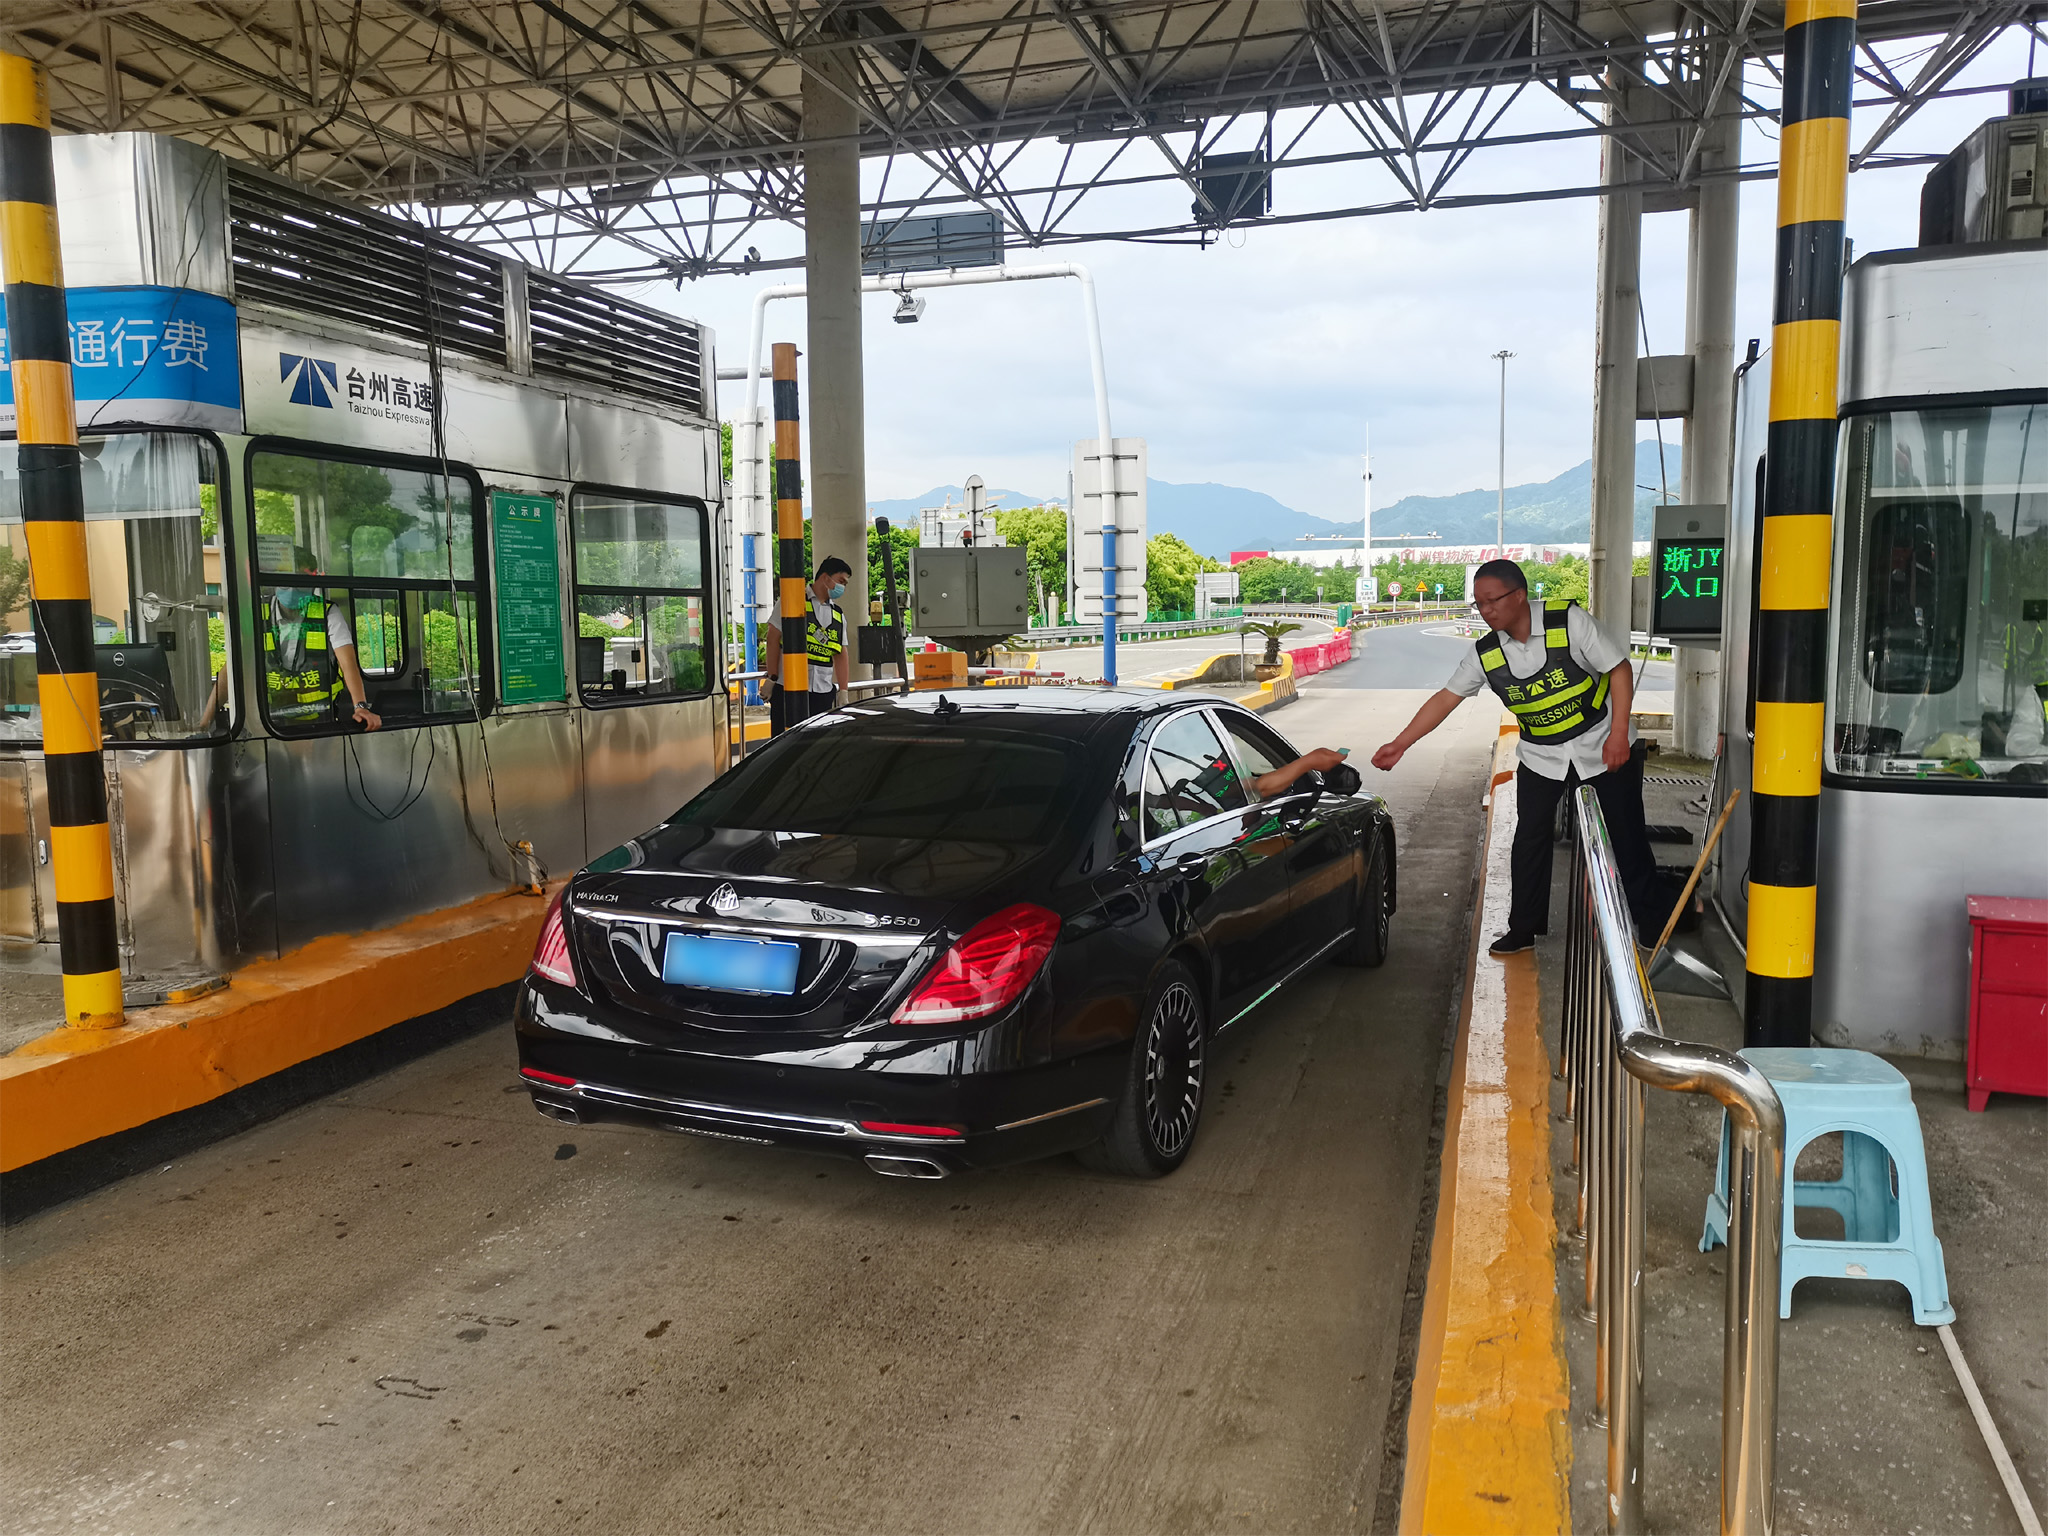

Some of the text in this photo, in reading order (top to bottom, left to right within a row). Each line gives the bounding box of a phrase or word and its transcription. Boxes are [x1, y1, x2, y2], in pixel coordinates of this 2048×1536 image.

[67, 317, 209, 371] 通行费
[346, 367, 434, 412] 台州高速
[348, 401, 434, 425] Taizhou Expresswa
[1663, 547, 1723, 572] 浙JY
[1662, 575, 1719, 599] 入口
[576, 891, 619, 903] MAYBACH
